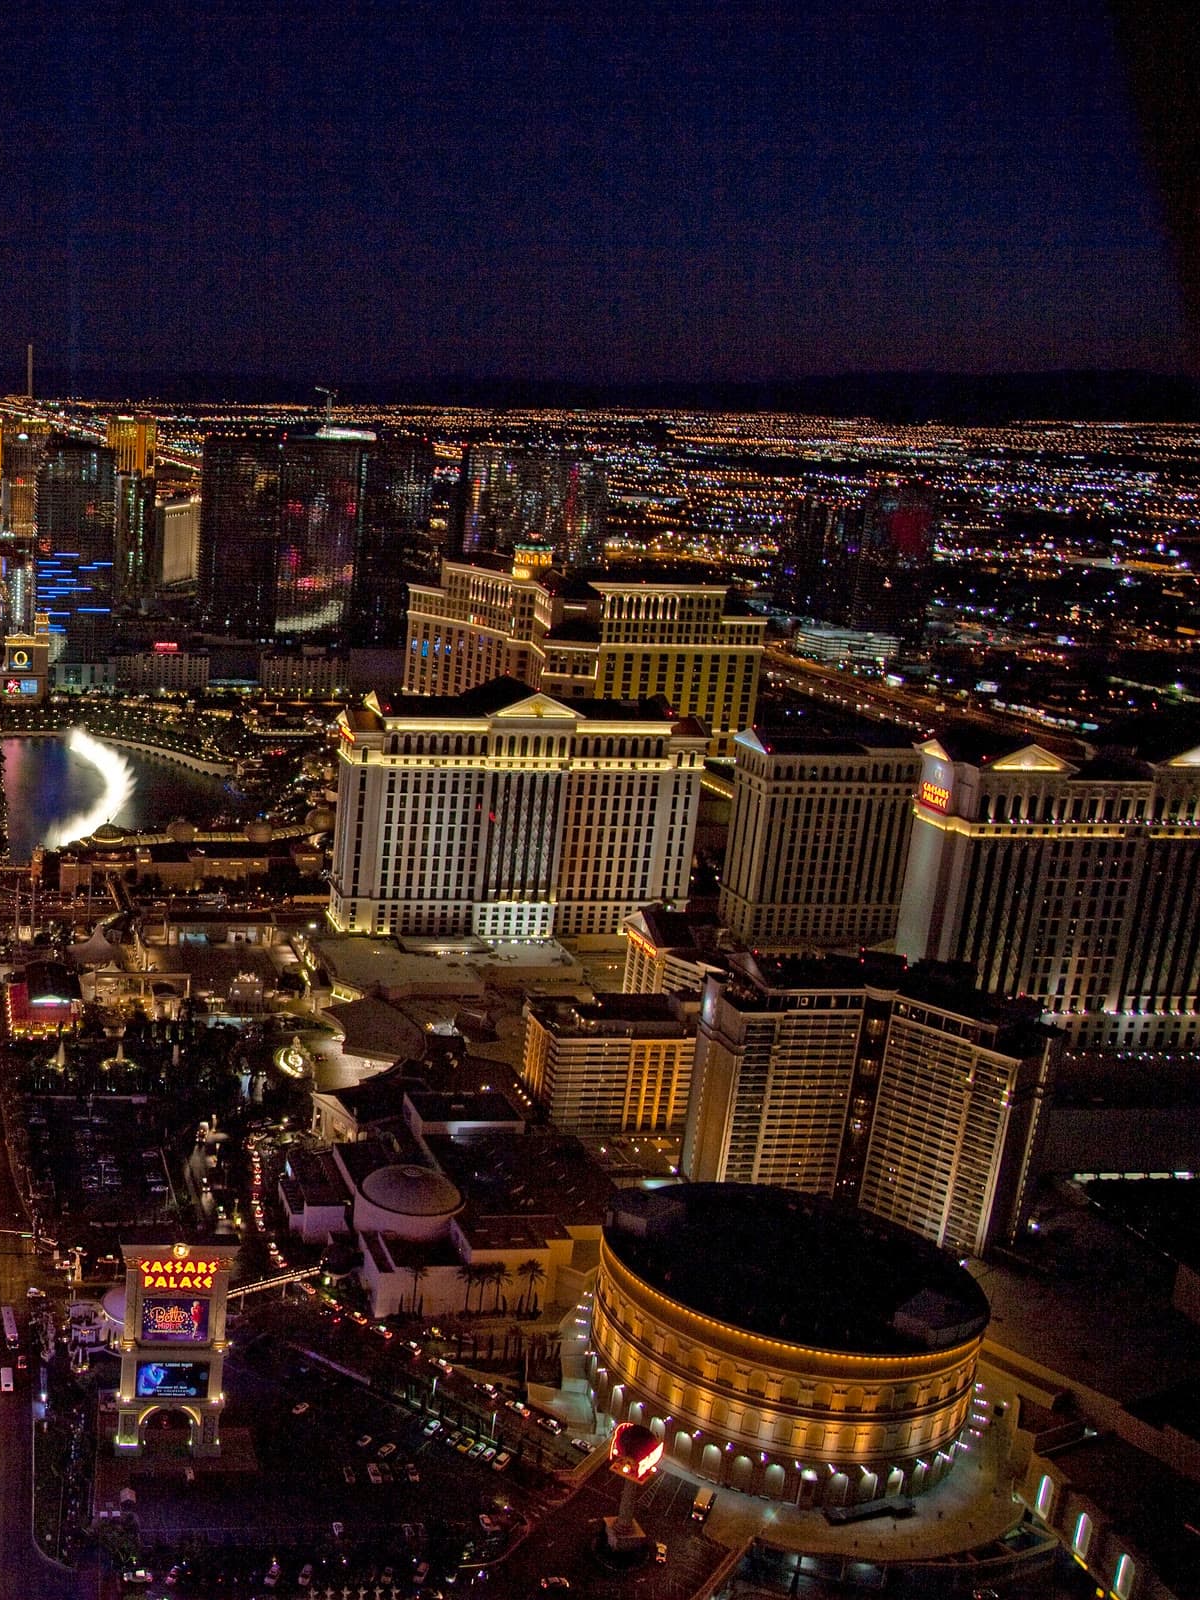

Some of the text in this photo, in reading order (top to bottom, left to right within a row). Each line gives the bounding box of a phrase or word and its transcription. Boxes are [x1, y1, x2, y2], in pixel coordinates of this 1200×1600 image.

[923, 782, 949, 800] CAESARS
[923, 791, 947, 809] PALACE
[140, 1260, 218, 1274] CAESARS
[144, 1276, 213, 1289] PALACE
[150, 1306, 188, 1323] Bette
